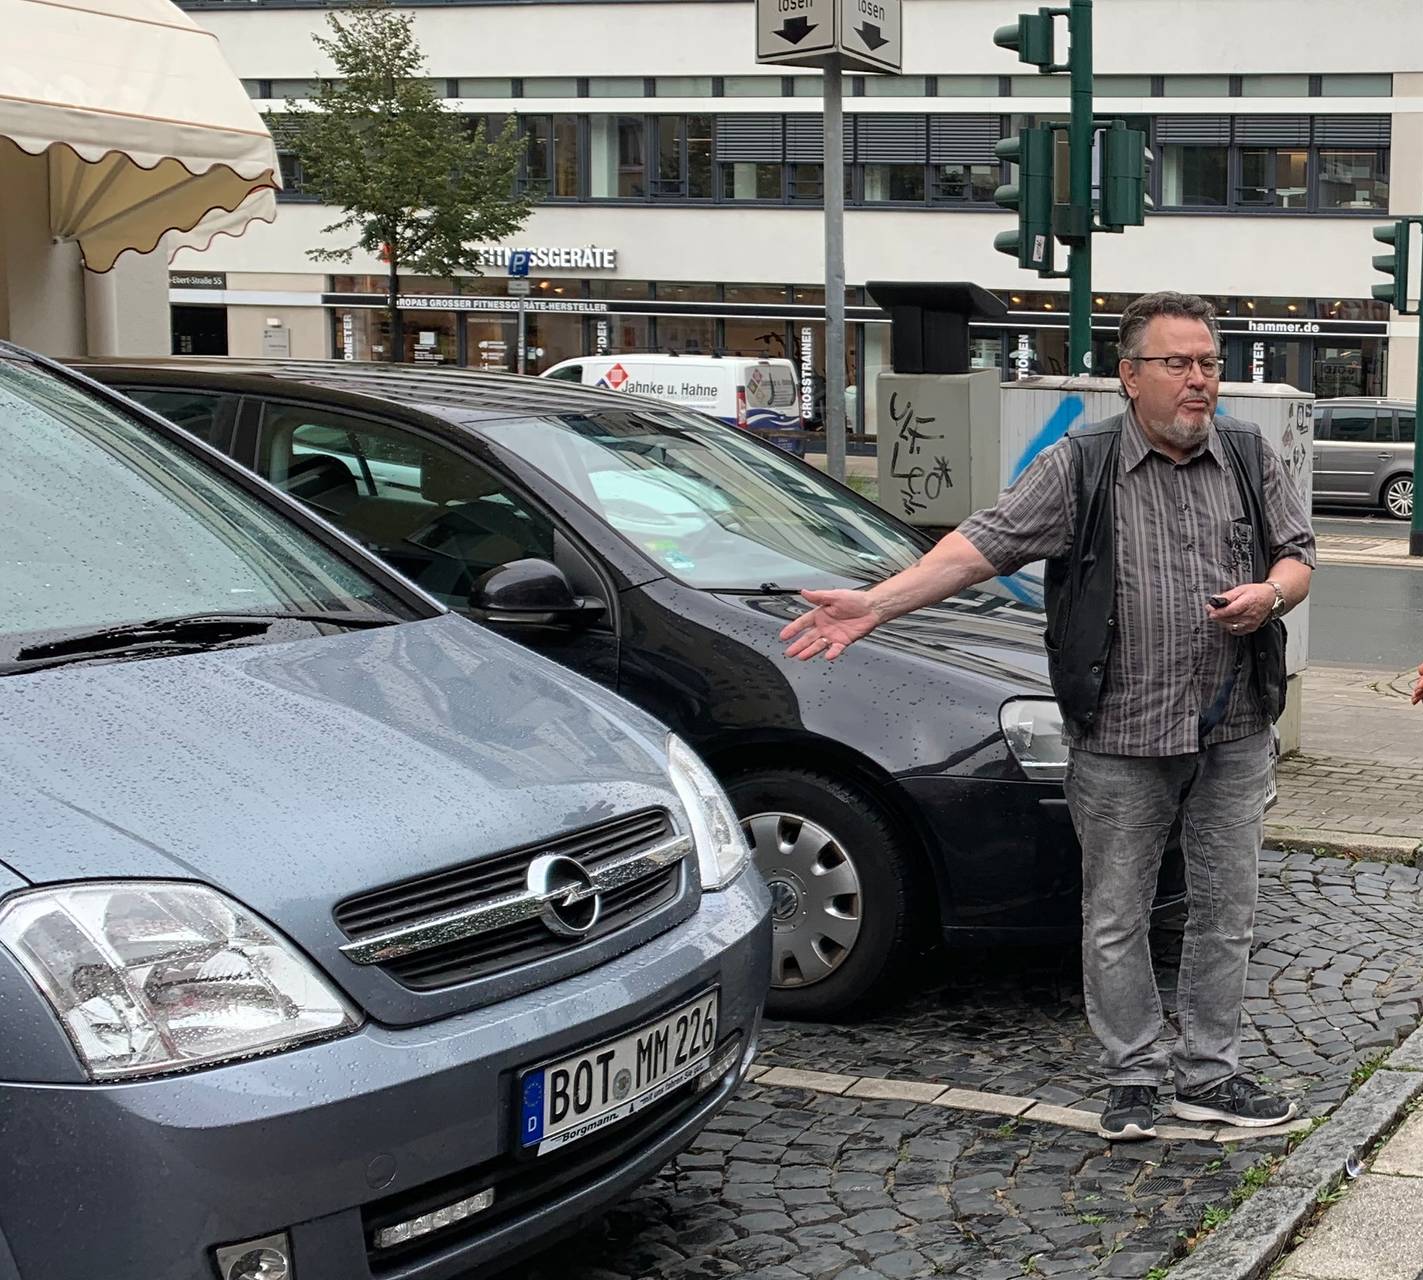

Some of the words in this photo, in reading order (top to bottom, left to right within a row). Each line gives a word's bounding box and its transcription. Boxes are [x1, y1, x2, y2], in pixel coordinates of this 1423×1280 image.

[512, 253, 526, 272] P
[429, 299, 471, 308] GROSSER
[473, 300, 608, 312] FITNESSGRÄTE-HERSTELLER
[1248, 321, 1320, 333] hammer.de
[802, 327, 812, 419] CROSSTRAINER
[621, 380, 663, 394] Jahnke
[667, 386, 677, 395] u.
[681, 382, 718, 397] Hahne
[550, 1050, 615, 1125] BOT
[636, 1025, 669, 1089] MM
[674, 1001, 713, 1067] 226
[528, 1116, 537, 1133] D
[562, 1113, 619, 1143] Borgmann
